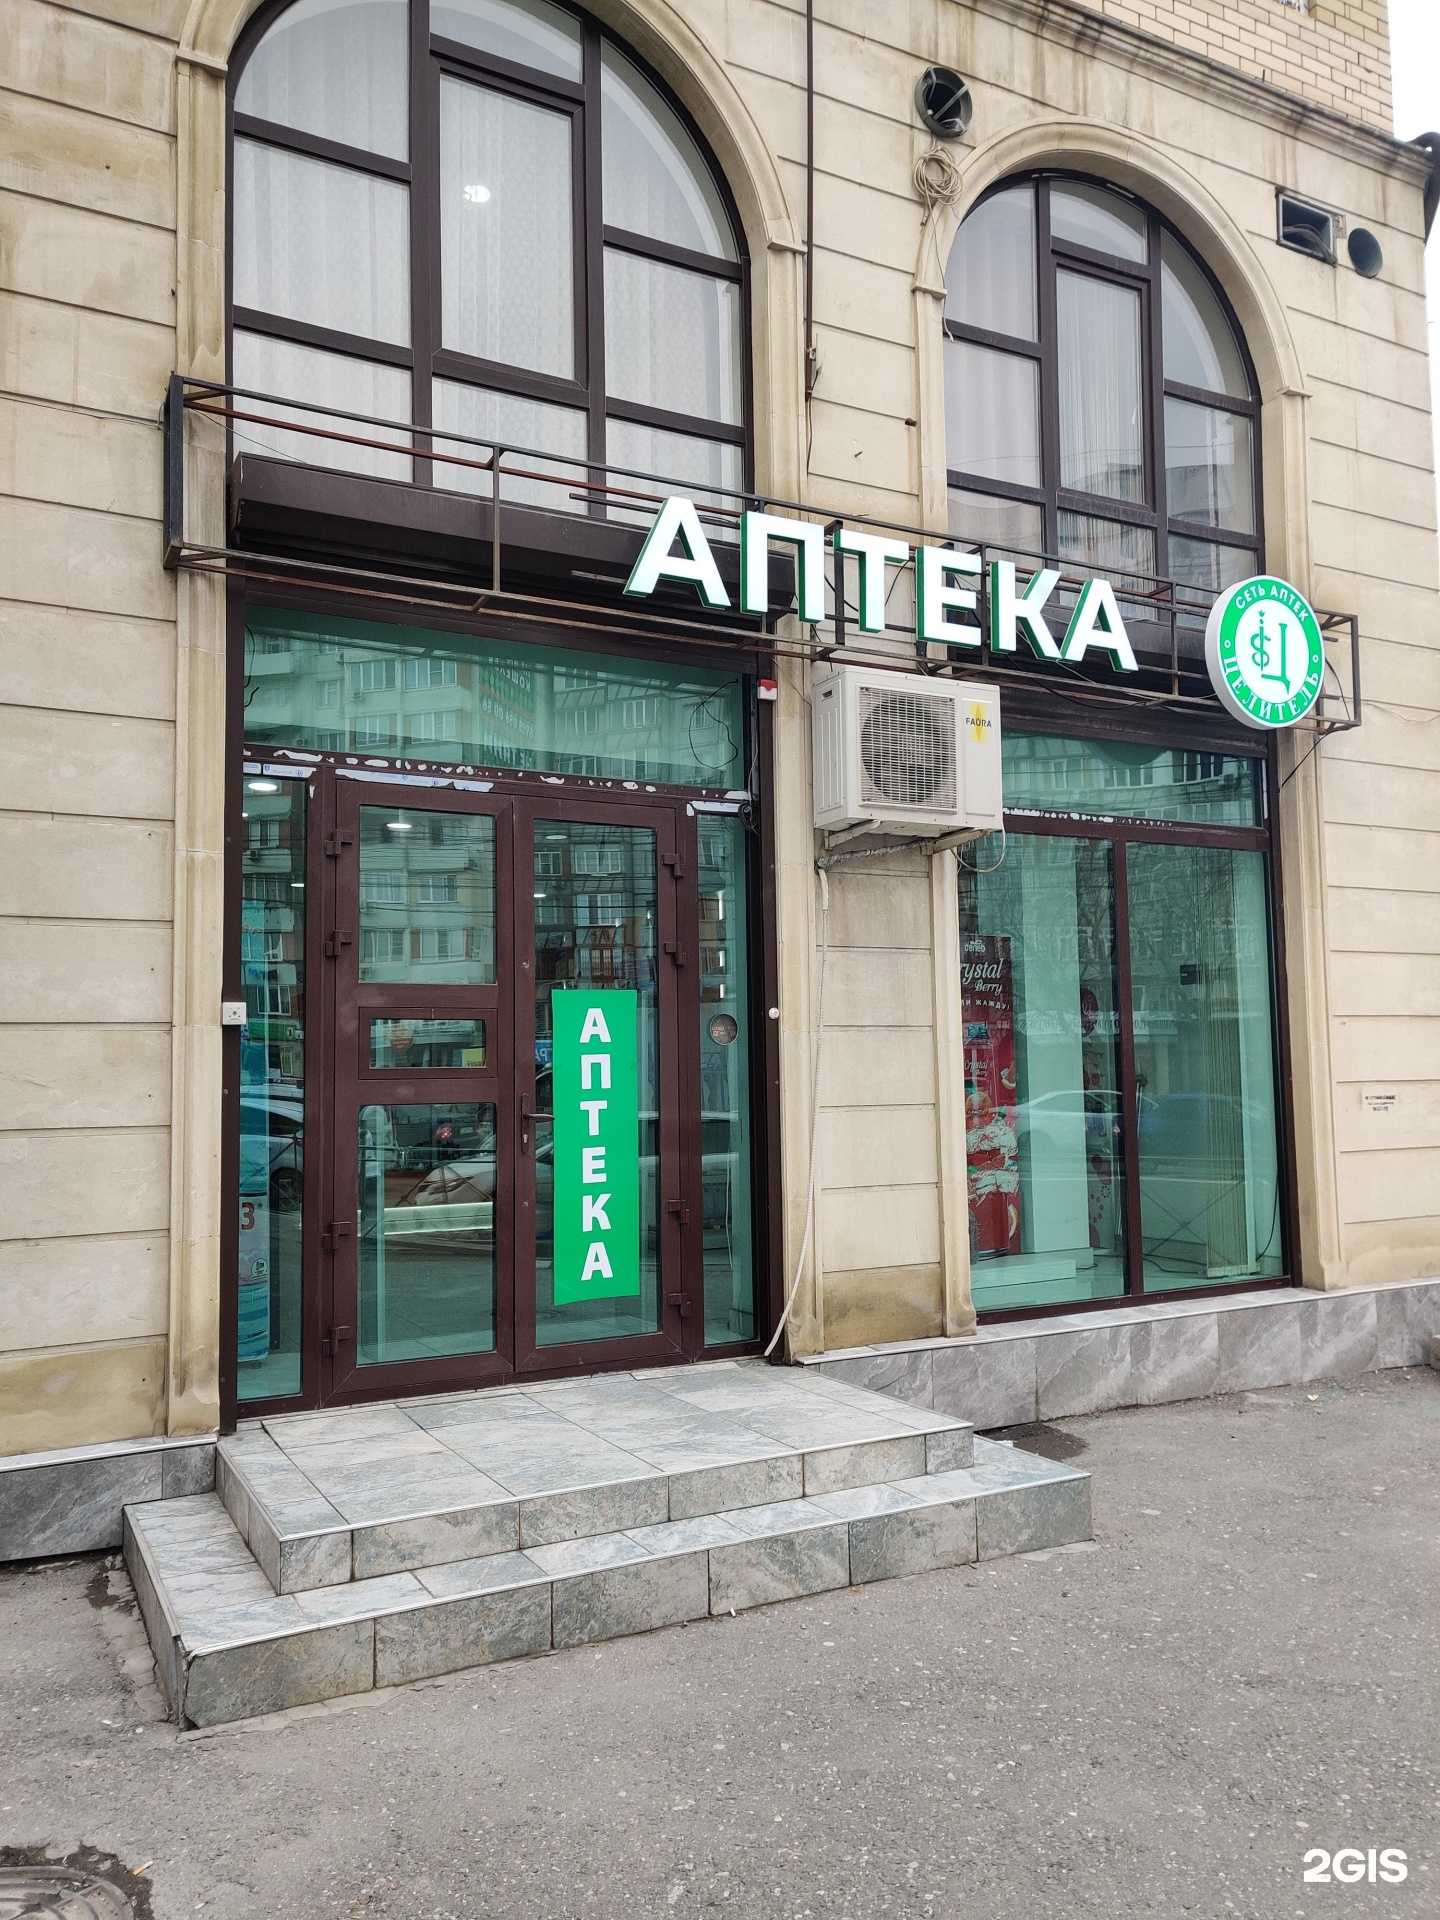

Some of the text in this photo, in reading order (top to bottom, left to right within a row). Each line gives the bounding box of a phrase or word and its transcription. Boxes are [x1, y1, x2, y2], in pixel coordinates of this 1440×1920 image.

[623, 496, 1139, 672] АПТЕКА
[1235, 584, 1310, 622] СЕТЬ АПТЕК
[1223, 656, 1319, 721] ЦЕЛИТЕЛЬ
[960, 957, 1004, 985] rystal
[975, 979, 1003, 996] Berry
[579, 1008, 614, 1281] АПТЕКА
